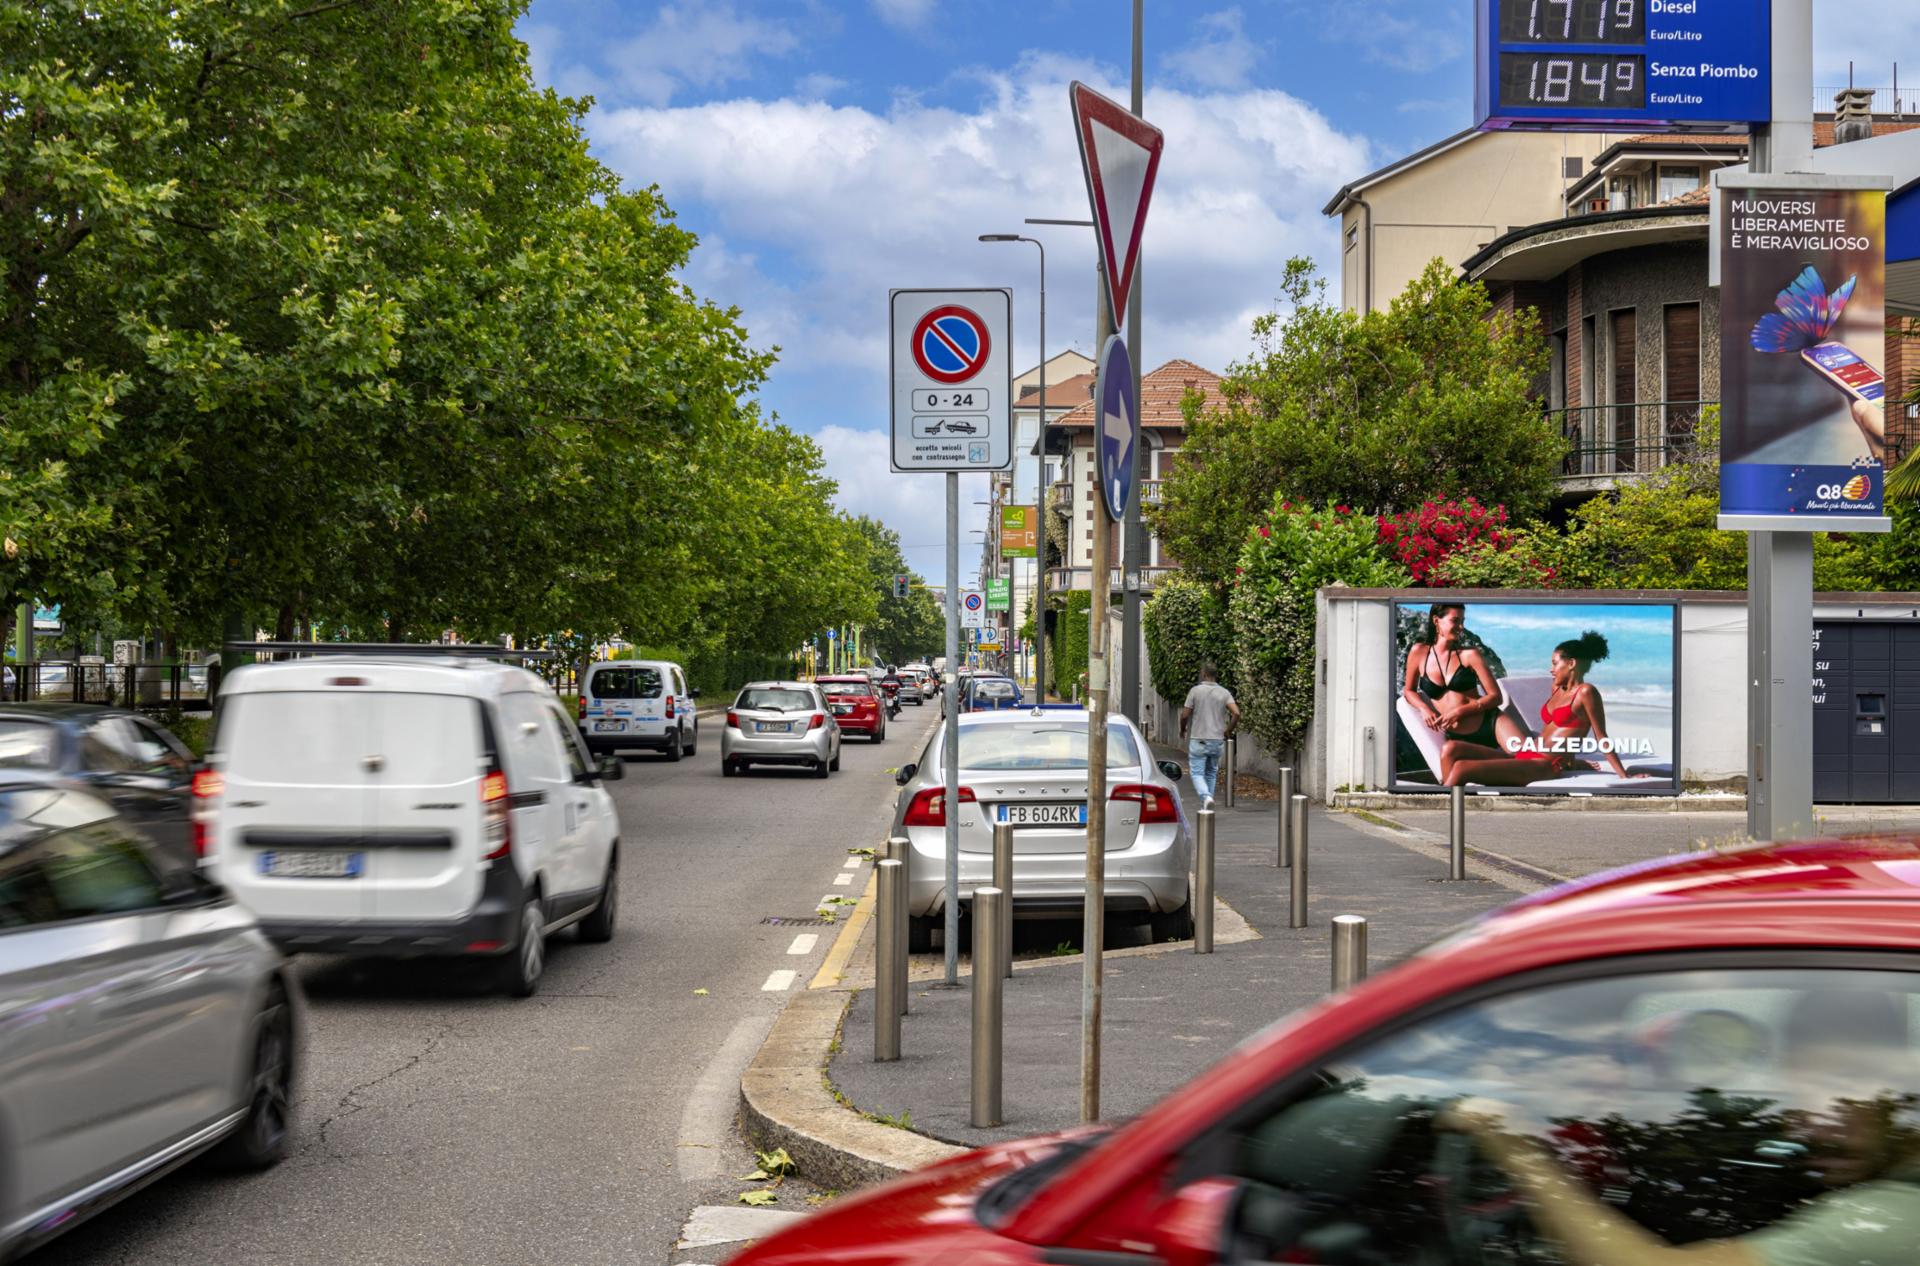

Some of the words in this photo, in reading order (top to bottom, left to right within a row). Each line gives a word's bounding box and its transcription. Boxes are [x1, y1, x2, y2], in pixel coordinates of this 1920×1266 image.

[1650, 0, 1697, 14] Diesel
[1650, 30, 1702, 41] Euro/Litro
[1650, 62, 1696, 77] Senza
[1700, 64, 1758, 79] Piombo
[1528, 60, 1635, 102] 1.849
[1650, 93, 1703, 104] Euro/Litro
[1732, 200, 1816, 215] MUOVERSI
[1732, 218, 1845, 232] LIBERAMENTE
[1732, 233, 1742, 248] È
[1747, 236, 1870, 250] MERAVIGLIOSO
[928, 394, 938, 406] 0
[953, 393, 973, 406] 24
[926, 454, 966, 462] contrassegno
[1816, 484, 1842, 500] Q8
[1815, 661, 1830, 671] su
[1506, 736, 1654, 754] CALZEDONIA
[1009, 807, 1027, 822] FB
[1032, 806, 1078, 822] 604RK
